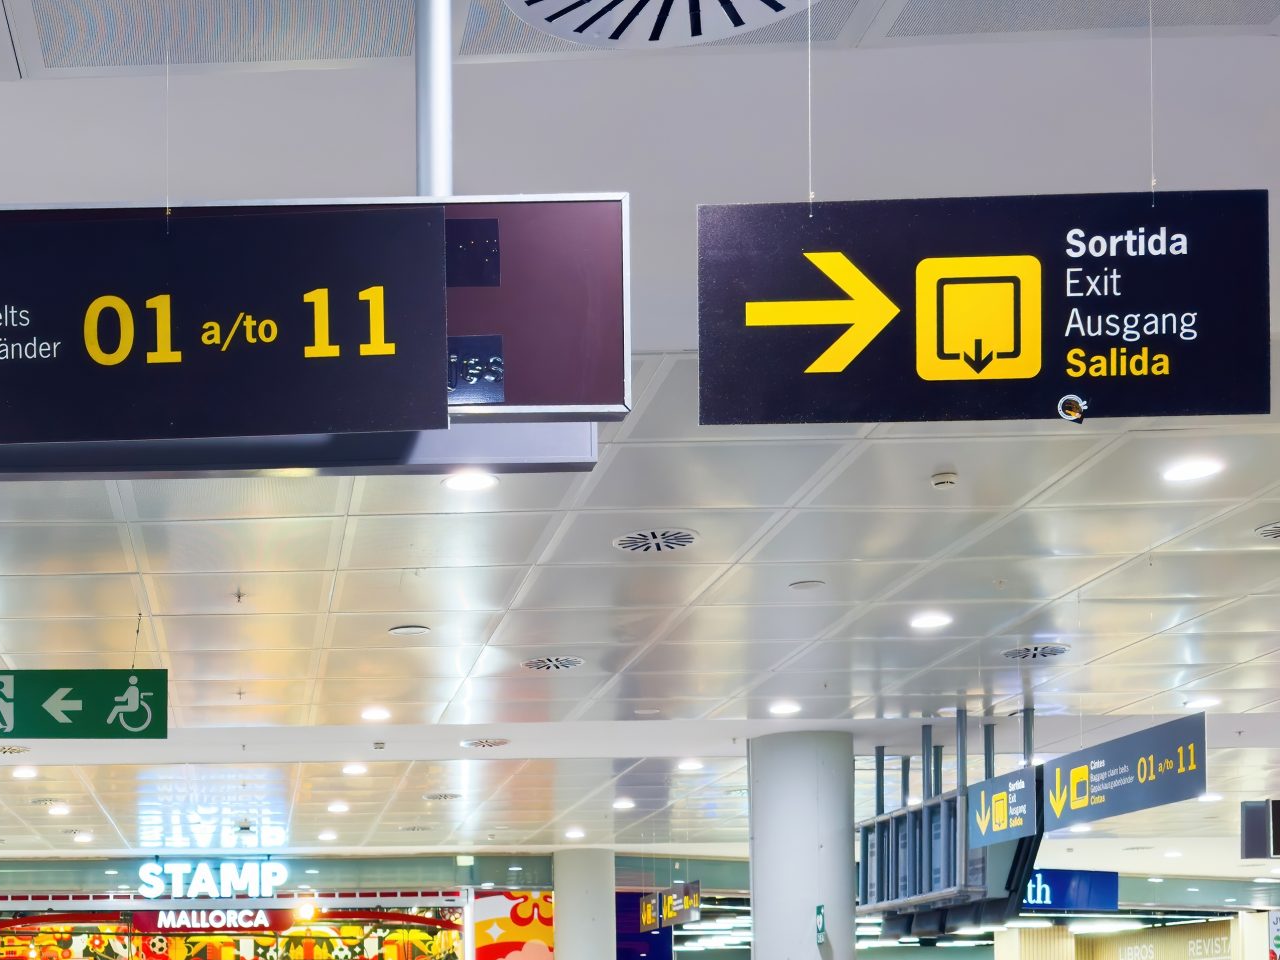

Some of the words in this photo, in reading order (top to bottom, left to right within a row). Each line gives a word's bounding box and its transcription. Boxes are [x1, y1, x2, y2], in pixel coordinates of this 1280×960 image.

[1065, 226, 1188, 258] Sortida
[1066, 266, 1122, 297] Exit
[82, 293, 183, 366] 01
[200, 312, 279, 351] a/to
[302, 285, 397, 358] 11
[1064, 307, 1198, 342] Ausgang
[1065, 346, 1170, 378] Salida
[1137, 754, 1156, 783] 01
[1177, 743, 1197, 774] 11
[138, 862, 289, 899] STAMP
[1022, 873, 1052, 905] th
[157, 909, 270, 929] MALLORCA
[1119, 944, 1154, 960] LIBROS
[1188, 937, 1231, 957] REVIST
